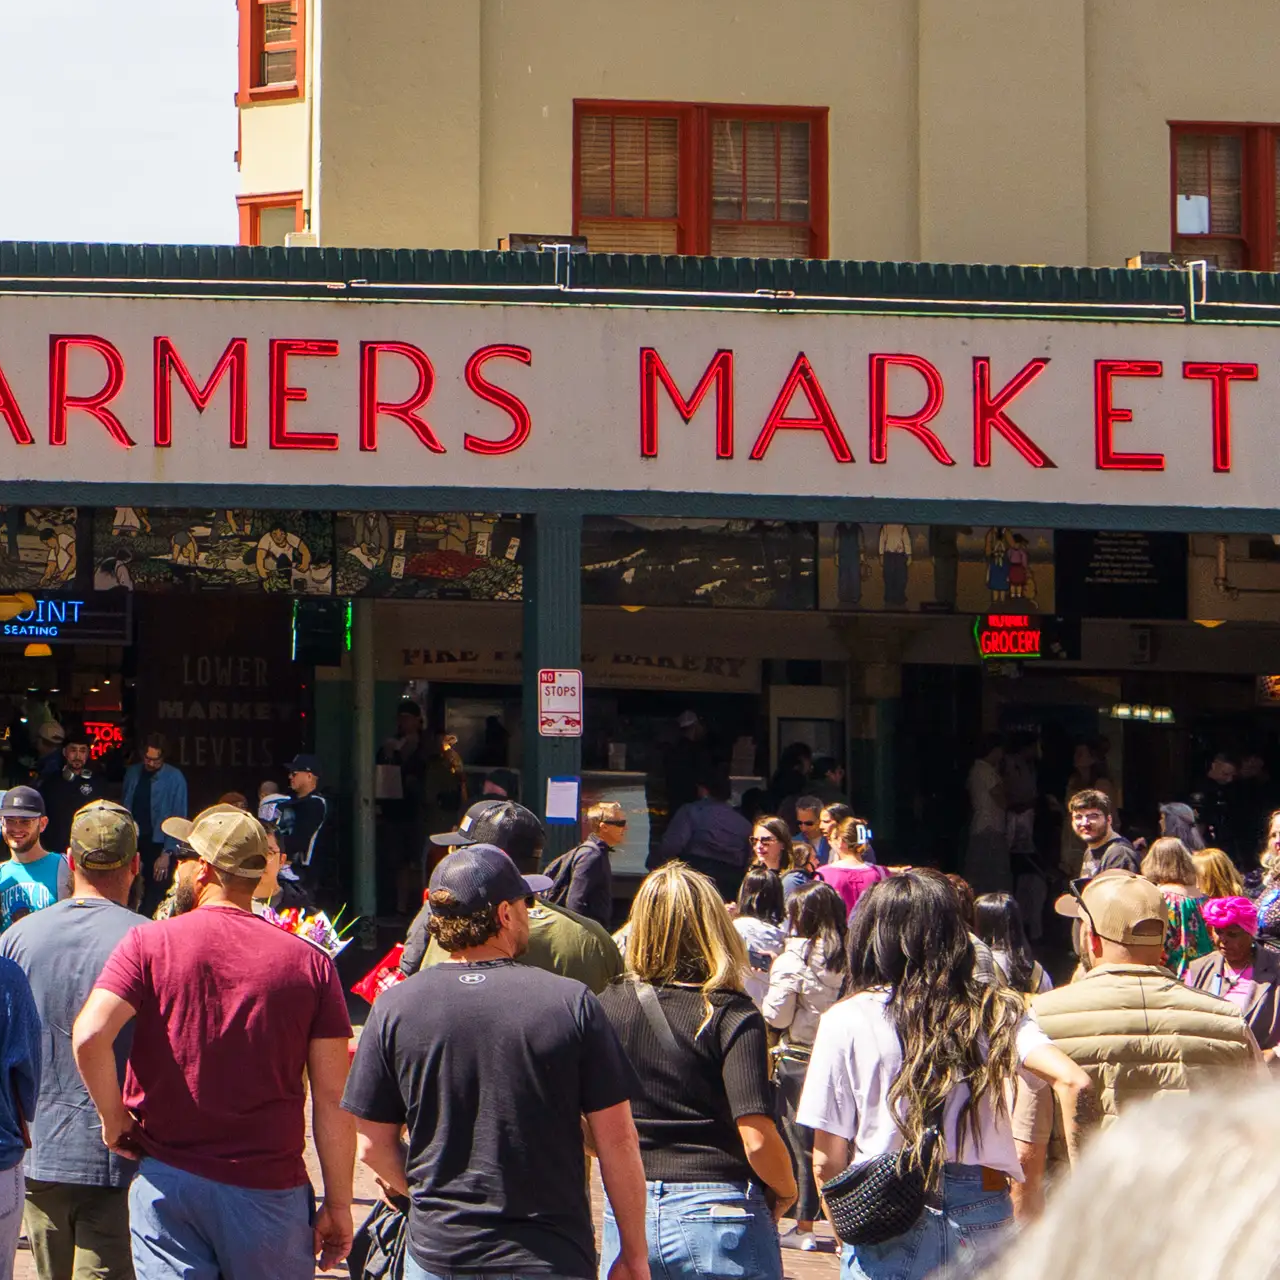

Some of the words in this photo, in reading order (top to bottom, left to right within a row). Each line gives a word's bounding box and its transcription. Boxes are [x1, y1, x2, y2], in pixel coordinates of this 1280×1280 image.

[639, 347, 1259, 473] MARKET
[4, 624, 58, 636] SEATING
[981, 630, 1041, 653] GROCERY
[182, 655, 268, 687] LOWER
[541, 672, 553, 682] NO
[545, 686, 576, 697] STOPS
[179, 736, 274, 767] LEVELS
